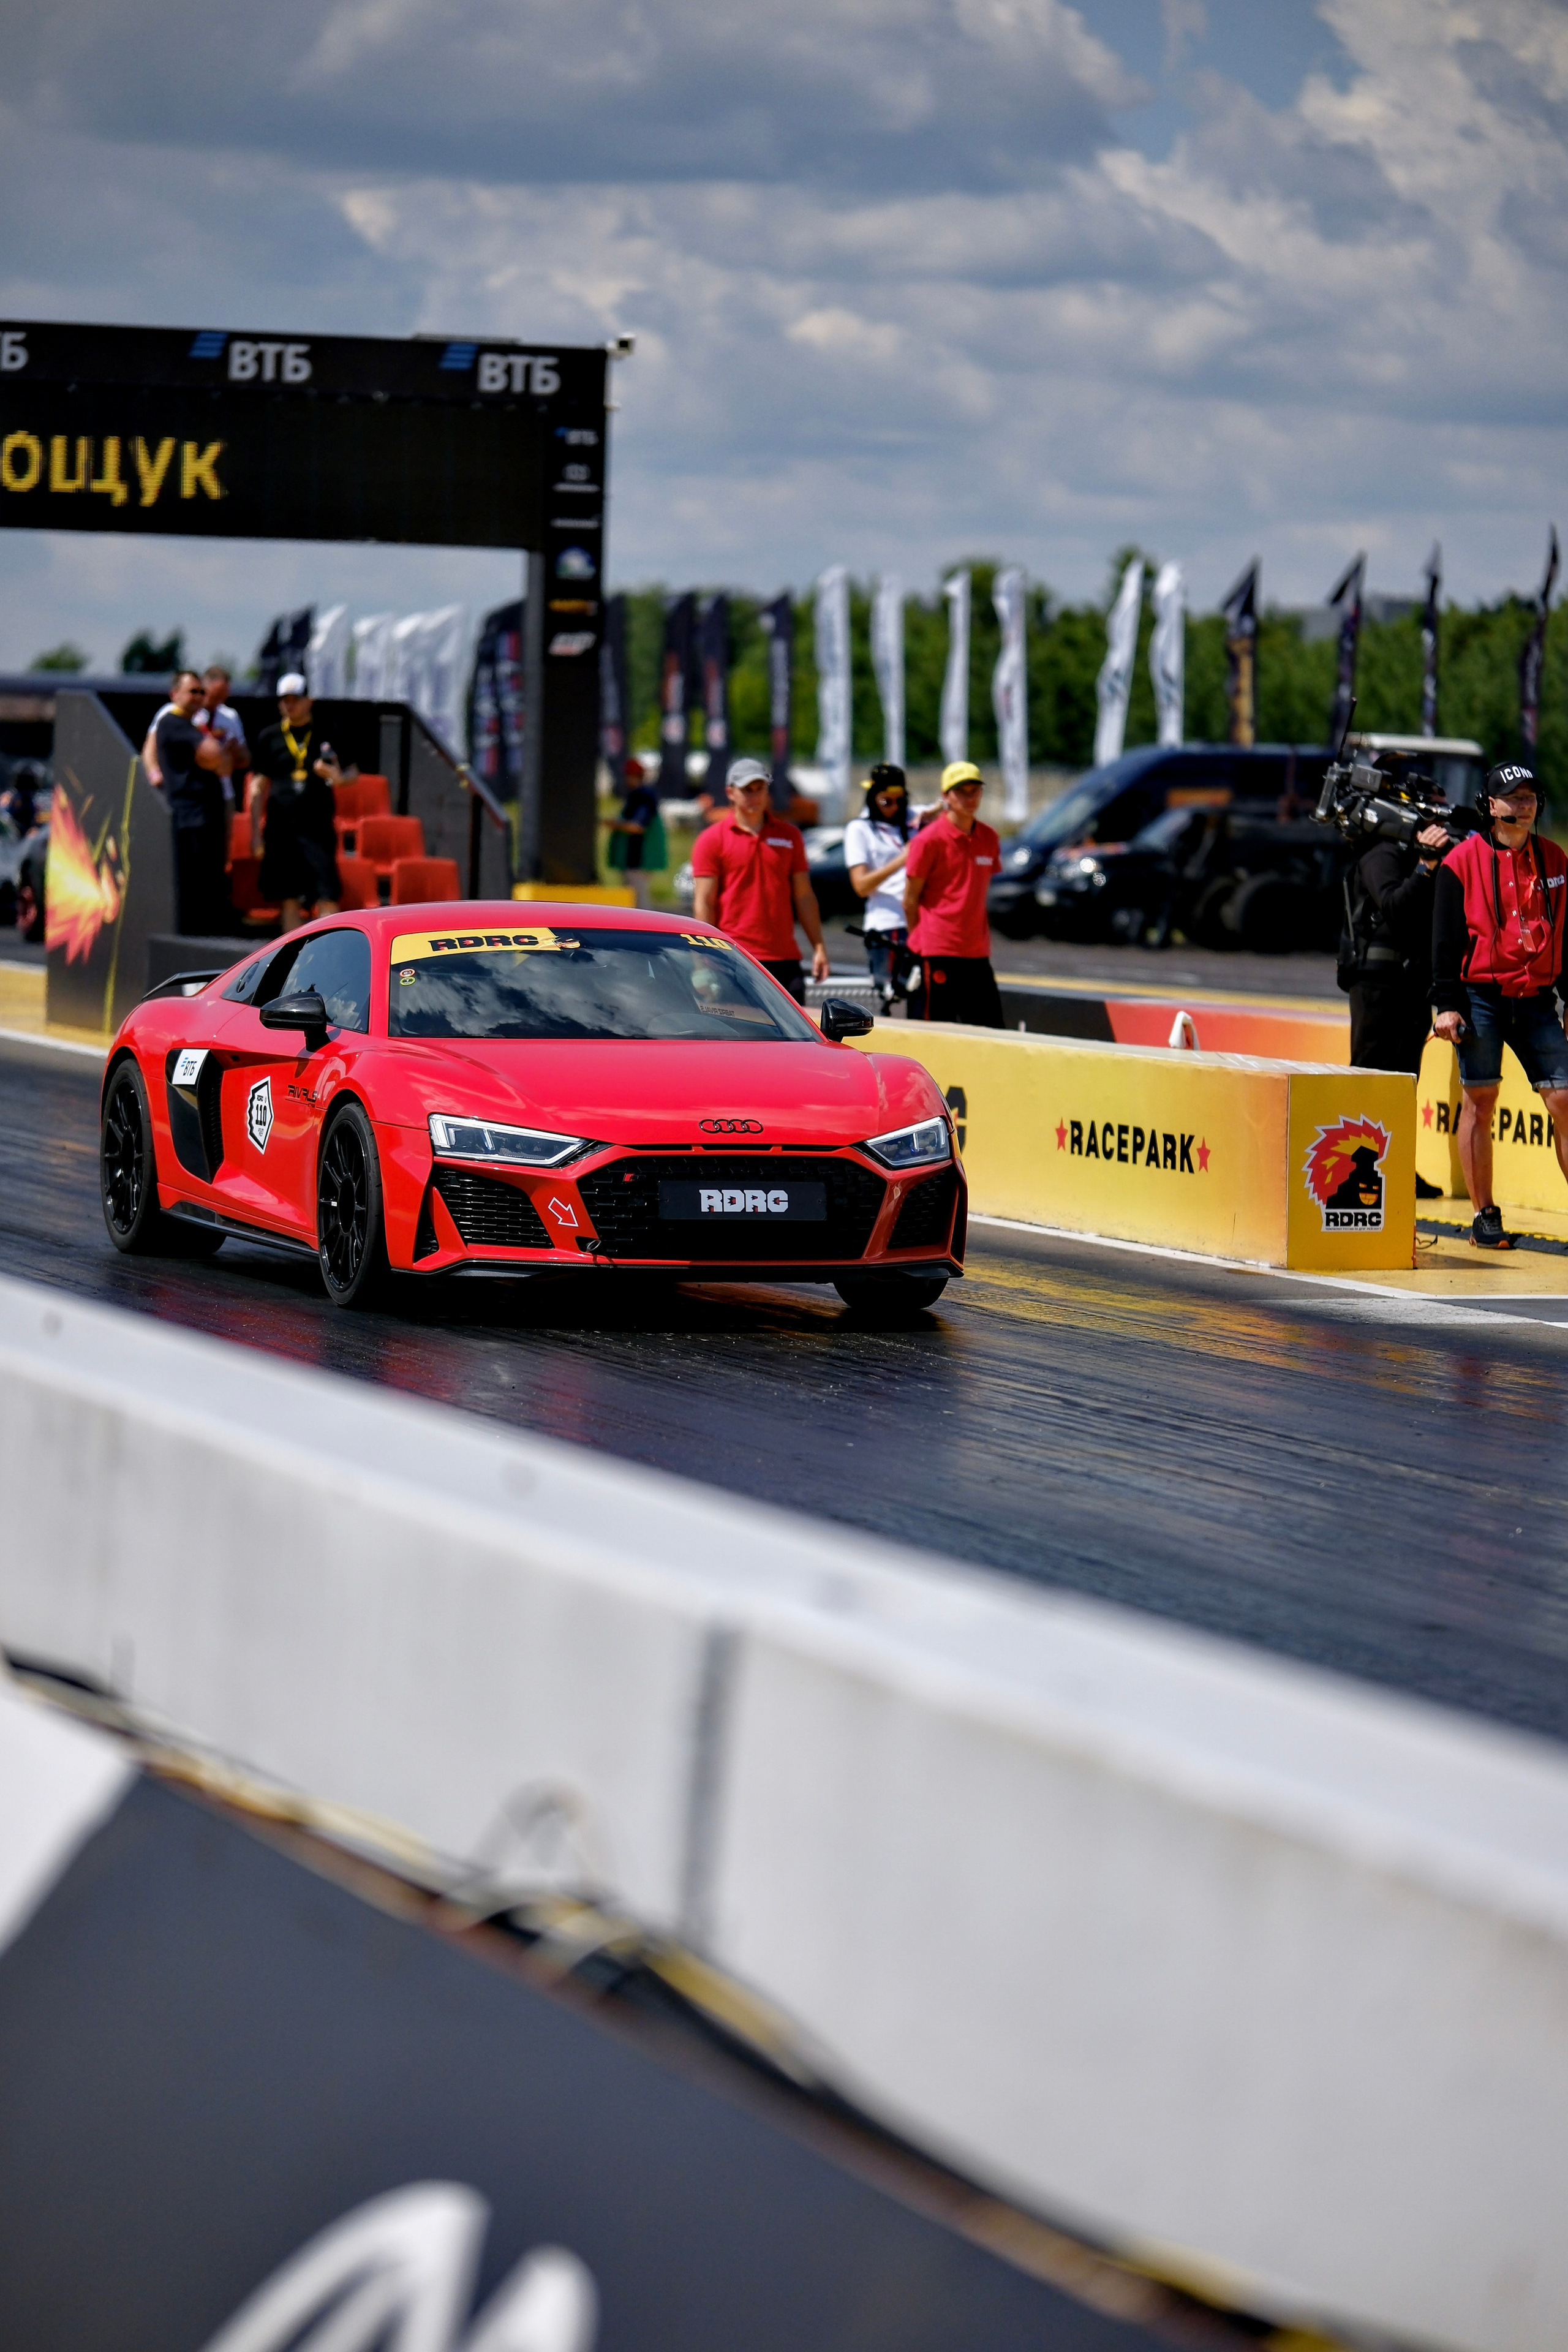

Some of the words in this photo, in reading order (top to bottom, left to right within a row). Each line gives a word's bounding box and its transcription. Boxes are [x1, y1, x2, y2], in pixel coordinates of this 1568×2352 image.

[0, 331, 28, 371] Б
[228, 341, 312, 383] ВТБ
[477, 353, 561, 395] ВТБ
[2, 430, 227, 507] ОЩУК
[428, 935, 540, 951] RDRC
[680, 933, 733, 951] 110
[183, 1061, 197, 1076] ВТБ
[255, 1104, 267, 1126] 110
[1436, 1102, 1555, 1148] RPARK
[1070, 1120, 1195, 1174] RACEPARK
[699, 1189, 788, 1212] RDRC
[1325, 1212, 1382, 1227] RDRC
